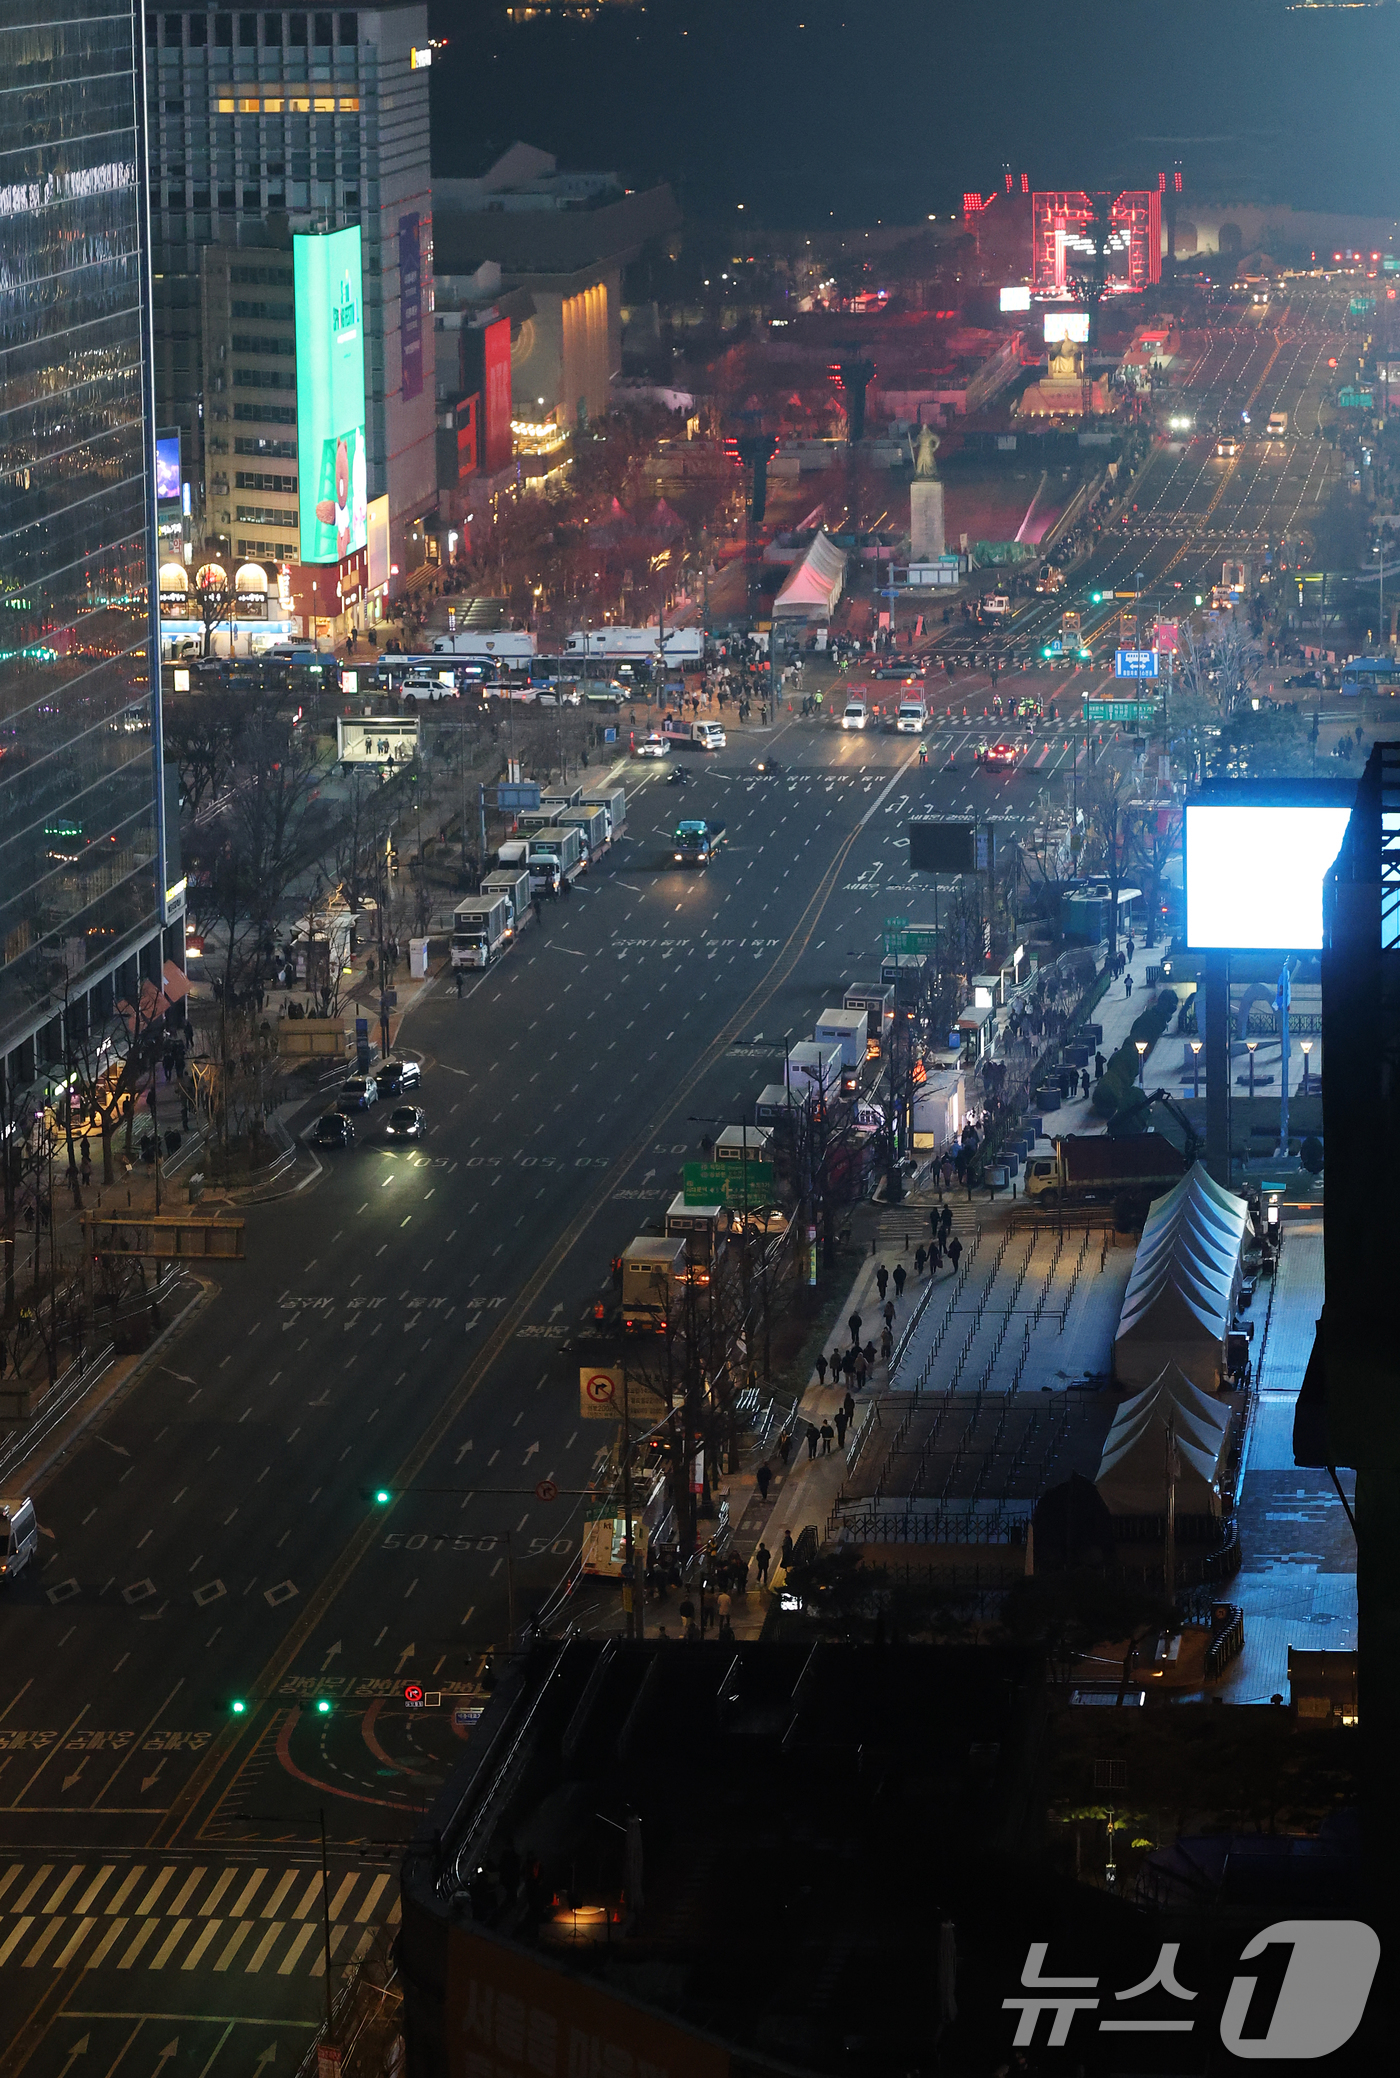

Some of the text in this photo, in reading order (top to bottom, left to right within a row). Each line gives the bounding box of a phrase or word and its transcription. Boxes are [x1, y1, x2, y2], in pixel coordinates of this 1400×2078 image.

[414, 1156, 450, 1167] 50
[467, 1156, 502, 1167] 50
[520, 1156, 556, 1167] 50
[575, 1156, 610, 1167] 50
[346, 1297, 387, 1309] 시청
[407, 1297, 448, 1309] 시청
[467, 1297, 507, 1309] 시청
[603, 1522, 612, 1530] kt
[381, 1533, 430, 1551] 50
[451, 1533, 499, 1551] 50
[528, 1538, 573, 1555] 50
[279, 1676, 346, 1696] 광화문
[64, 1730, 136, 1750] 숭례문
[142, 1731, 213, 1751] 숭례문
